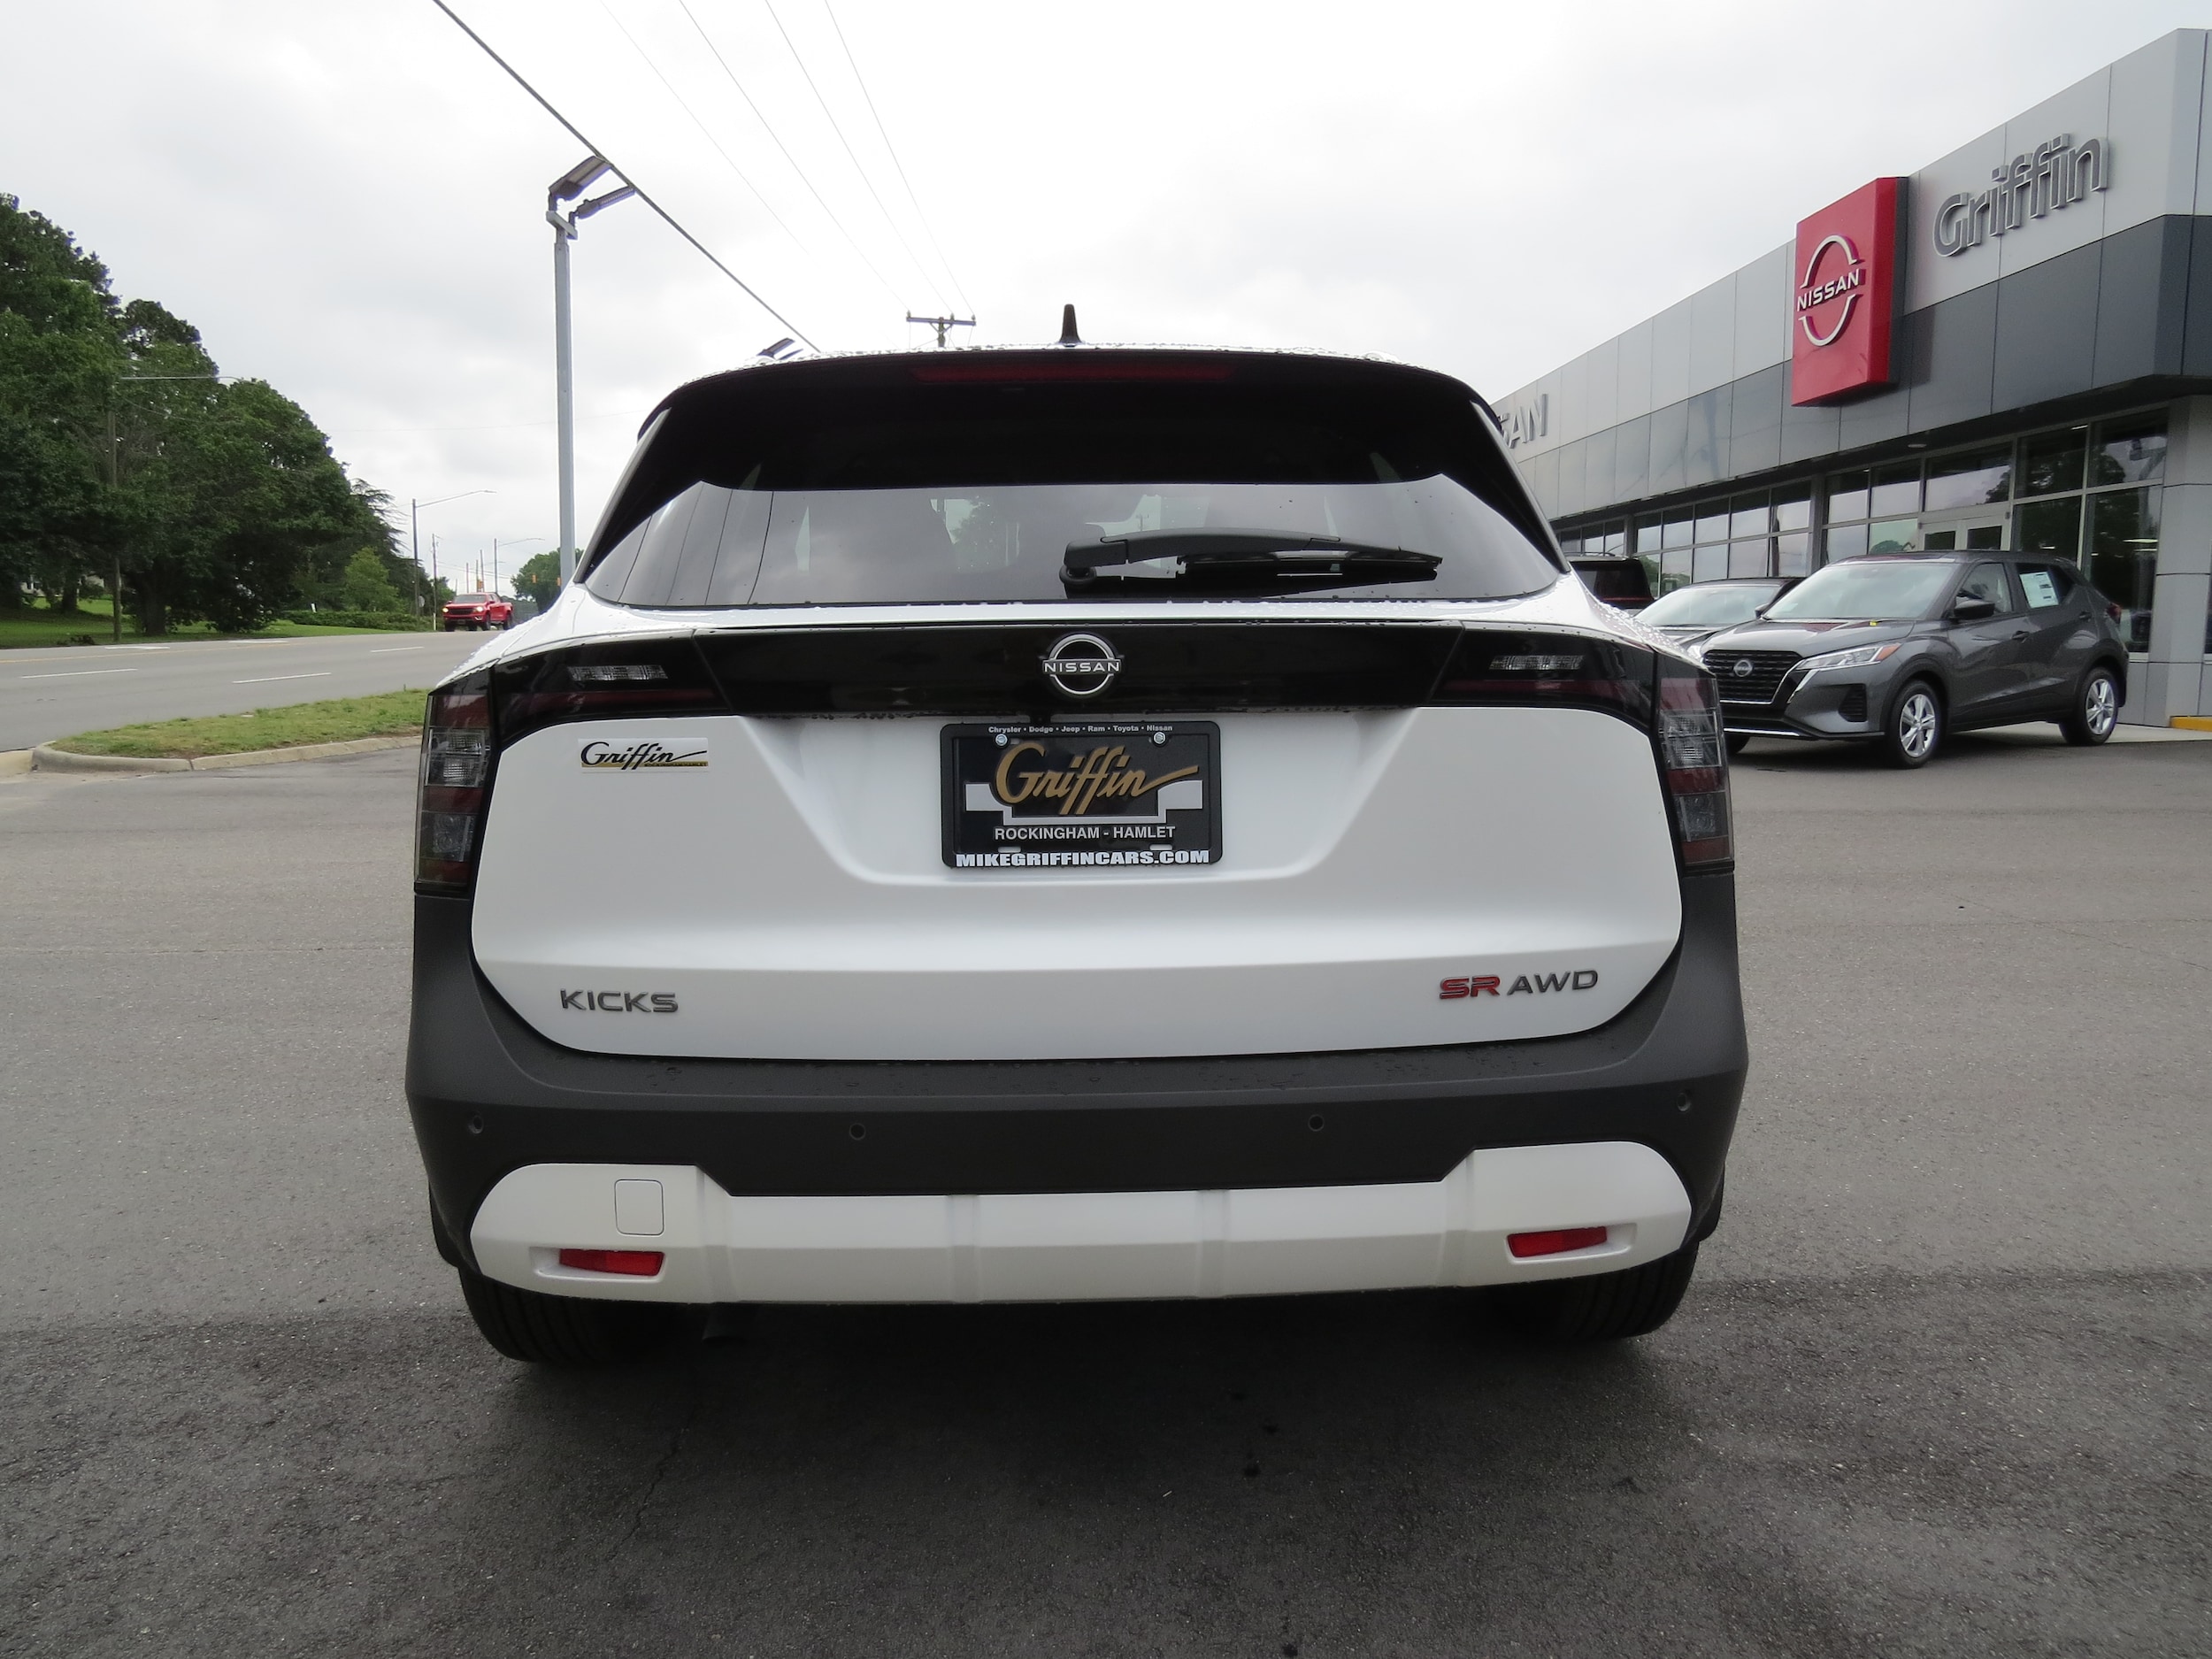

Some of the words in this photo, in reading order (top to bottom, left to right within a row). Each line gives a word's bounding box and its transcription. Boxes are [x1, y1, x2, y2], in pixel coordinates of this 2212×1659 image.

[1932, 133, 2108, 257] Griffin
[1797, 268, 1860, 312] NISSAN
[1044, 662, 1119, 672] NISSAN
[988, 726, 1022, 734] Chrysler
[1061, 725, 1080, 733] Jeep
[1112, 725, 1140, 733] Toyota
[580, 741, 708, 770] Griffin
[995, 741, 1199, 815] Griffin
[995, 826, 1100, 841] ROCKINGHAM
[1113, 826, 1176, 839] HAMLET
[956, 850, 1210, 867] MIKEGRIFFINCARS.COM
[1439, 975, 1502, 1000] SR
[1506, 970, 1599, 996] AWD
[560, 988, 679, 1013] KICKS
